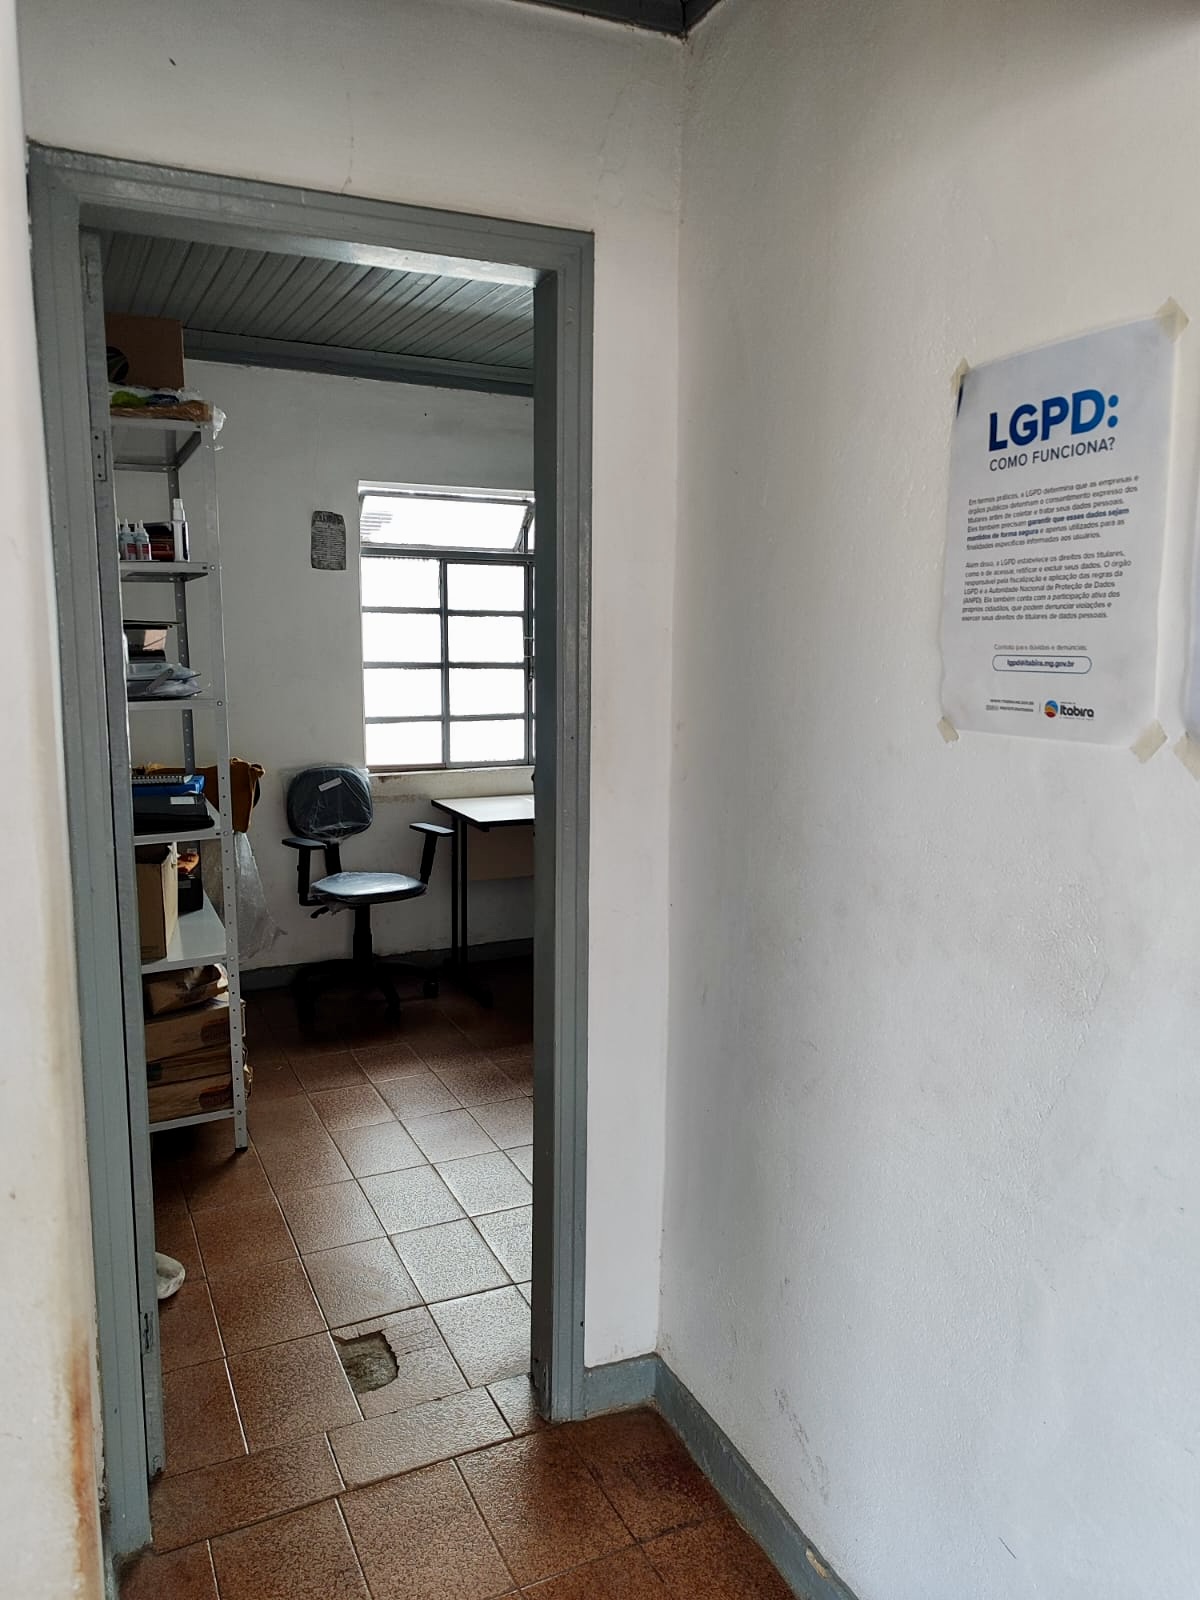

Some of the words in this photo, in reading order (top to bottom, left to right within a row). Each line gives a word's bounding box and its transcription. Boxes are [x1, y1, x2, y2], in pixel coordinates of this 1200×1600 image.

[989, 389, 1118, 452] LGPD:
[990, 453, 1027, 471] COMO
[1032, 437, 1116, 464] FUNCIONA?
[1060, 705, 1094, 718] Itabira
